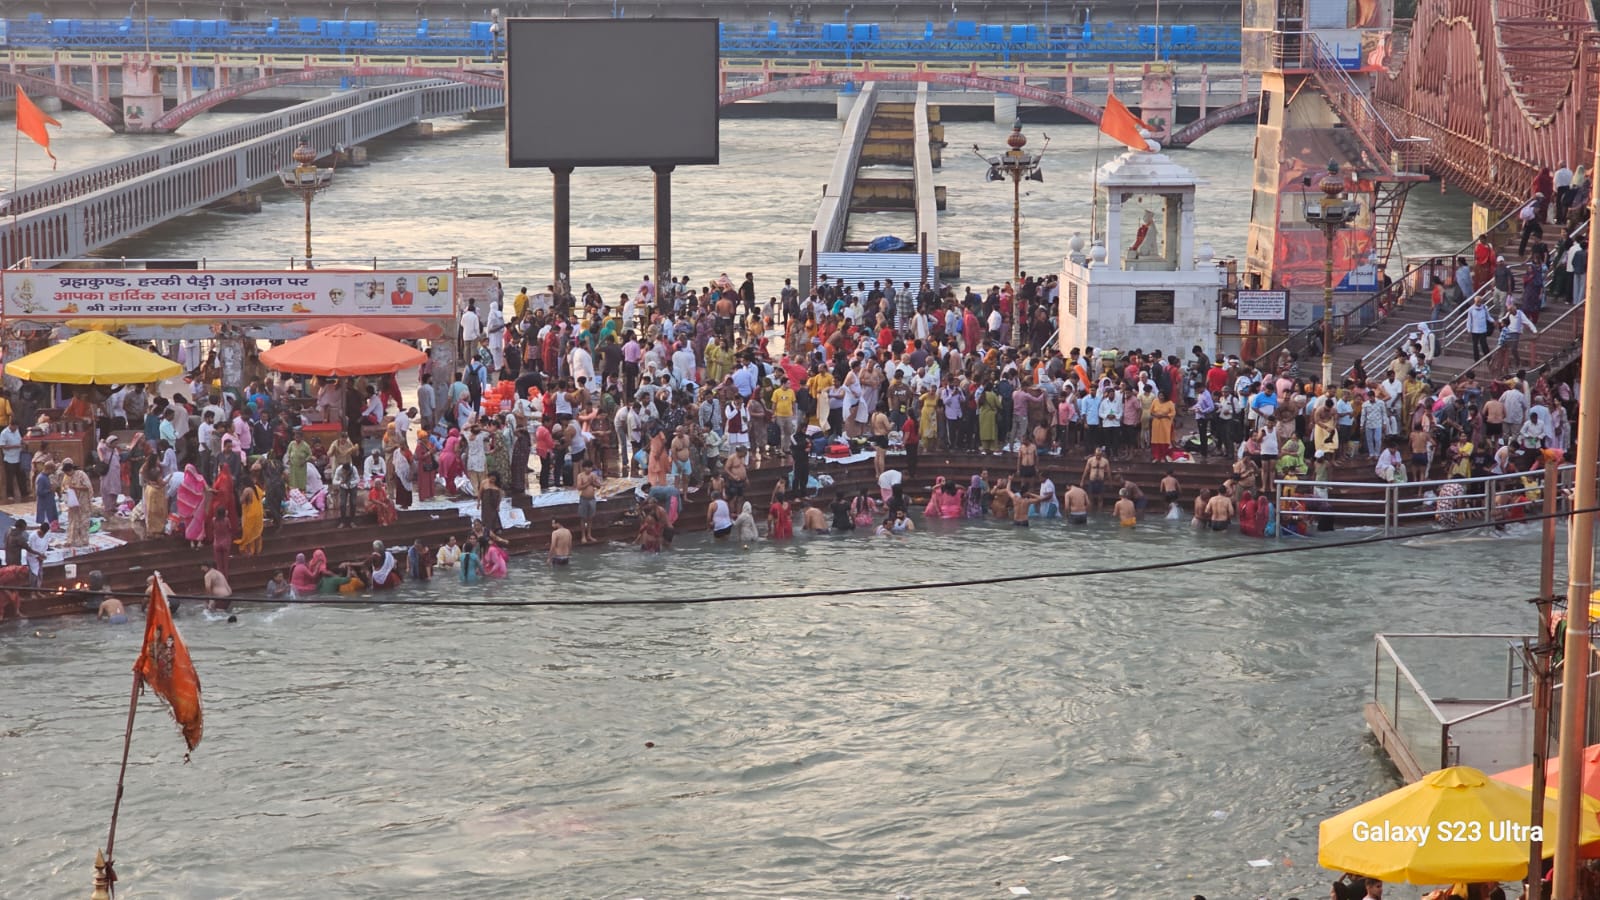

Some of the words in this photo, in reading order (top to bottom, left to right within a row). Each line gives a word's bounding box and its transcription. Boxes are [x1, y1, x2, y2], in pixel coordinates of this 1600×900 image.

[138, 275, 181, 287] हरकी
[187, 275, 215, 290] पैड़ी
[220, 277, 282, 286] आगमन
[287, 277, 309, 286] पर
[53, 291, 104, 301] आपका
[109, 289, 155, 301] हार्दिक
[161, 291, 211, 301] स्वागत
[215, 289, 236, 301] एवं
[241, 289, 317, 301] अभिनन्दन
[86, 303, 104, 312] श्री
[109, 304, 141, 312] गंगा
[236, 303, 285, 312] हरिद्वार
